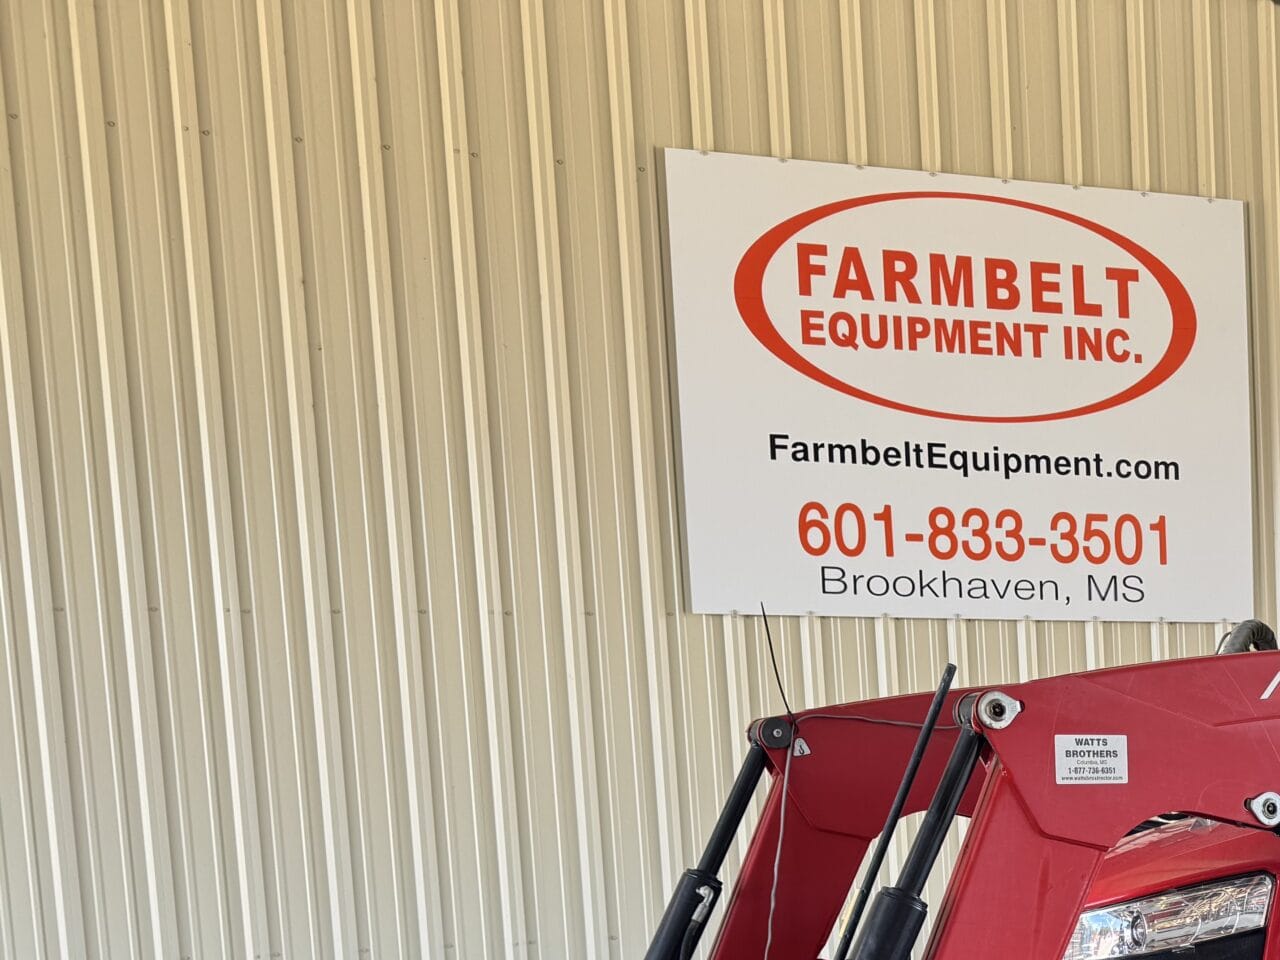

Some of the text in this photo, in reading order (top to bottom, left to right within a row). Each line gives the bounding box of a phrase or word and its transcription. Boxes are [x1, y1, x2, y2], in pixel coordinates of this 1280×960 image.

[796, 242, 1140, 319] FARMBELT
[800, 309, 1143, 363] EQUIPMENT INC.
[768, 433, 1181, 480] FarmbeltEquipment.com
[798, 501, 1168, 566] 601-833-3501
[819, 566, 1146, 605] Brookhaven, MS
[1065, 750, 1118, 758] BROTHERS
[1074, 738, 1108, 747] WATTS
